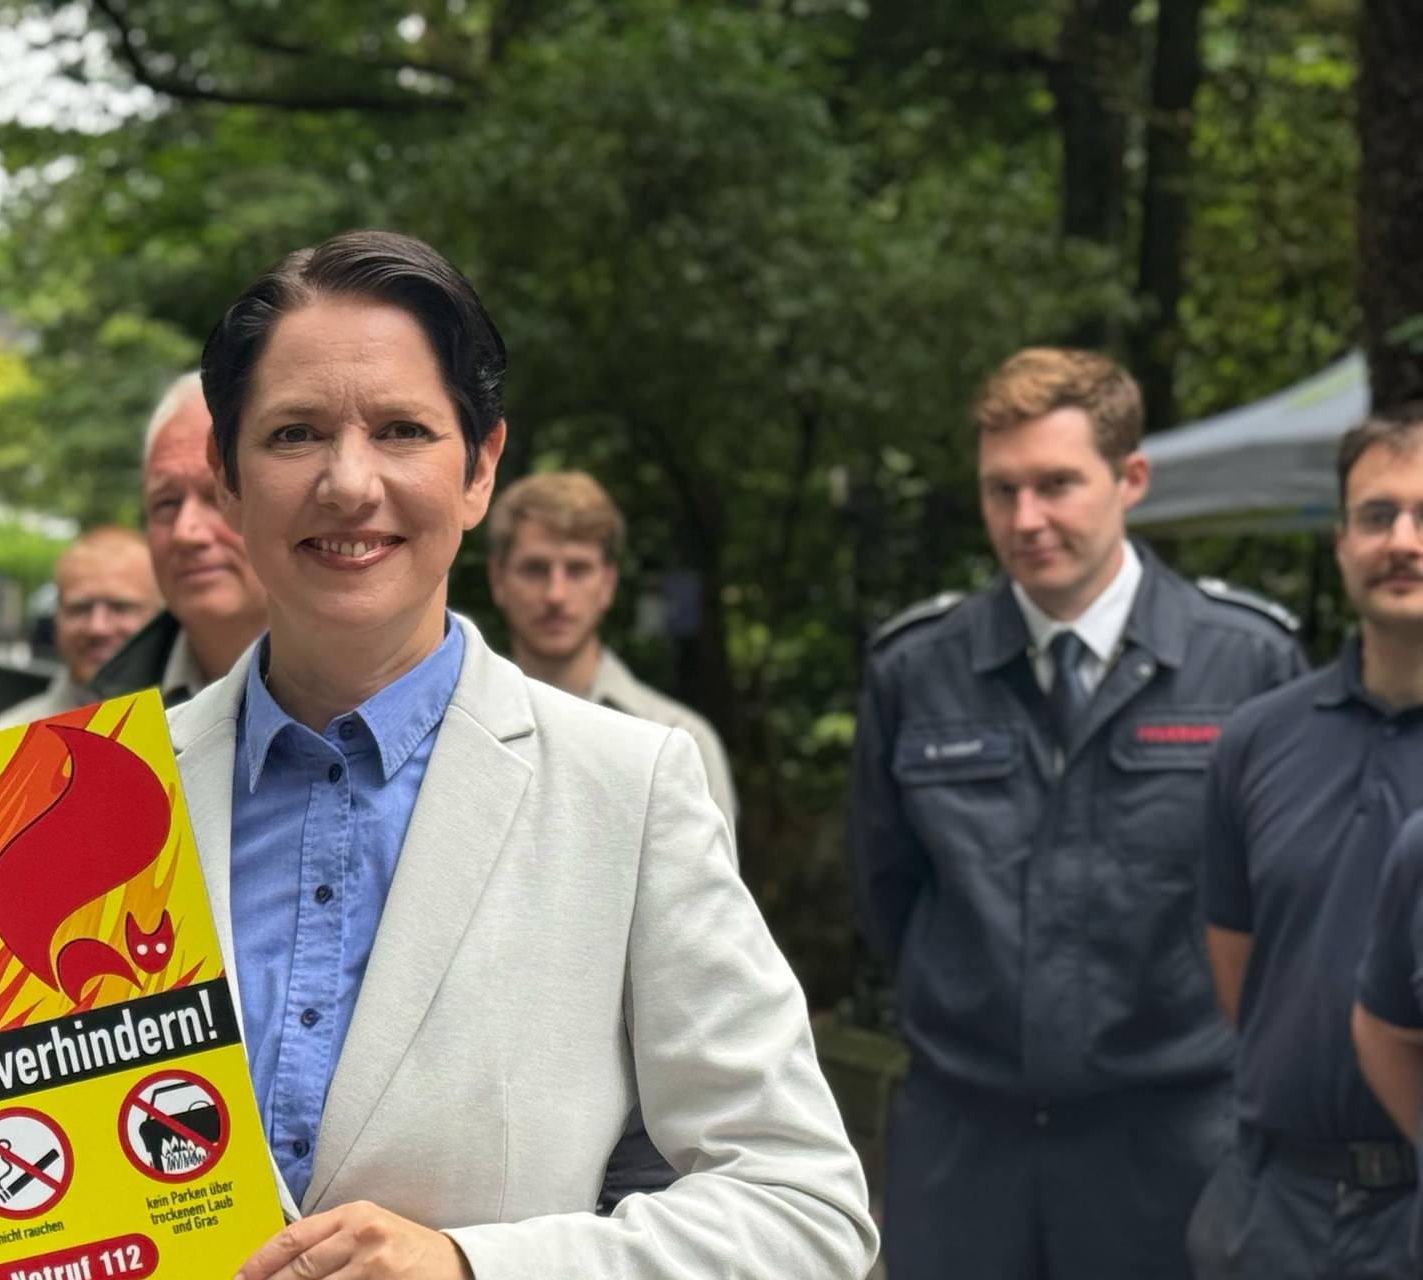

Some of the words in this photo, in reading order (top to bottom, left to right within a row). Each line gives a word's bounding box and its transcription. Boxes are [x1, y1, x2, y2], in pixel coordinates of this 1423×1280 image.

[146, 1195, 169, 1210] kein
[170, 1187, 207, 1205] Parken
[209, 1181, 233, 1196] über
[150, 1203, 206, 1225] trockenem
[207, 1195, 233, 1212] Laub
[24, 1221, 65, 1239] rauchen
[172, 1219, 192, 1235] und
[194, 1215, 219, 1230] Gras
[99, 1244, 144, 1276] 112
